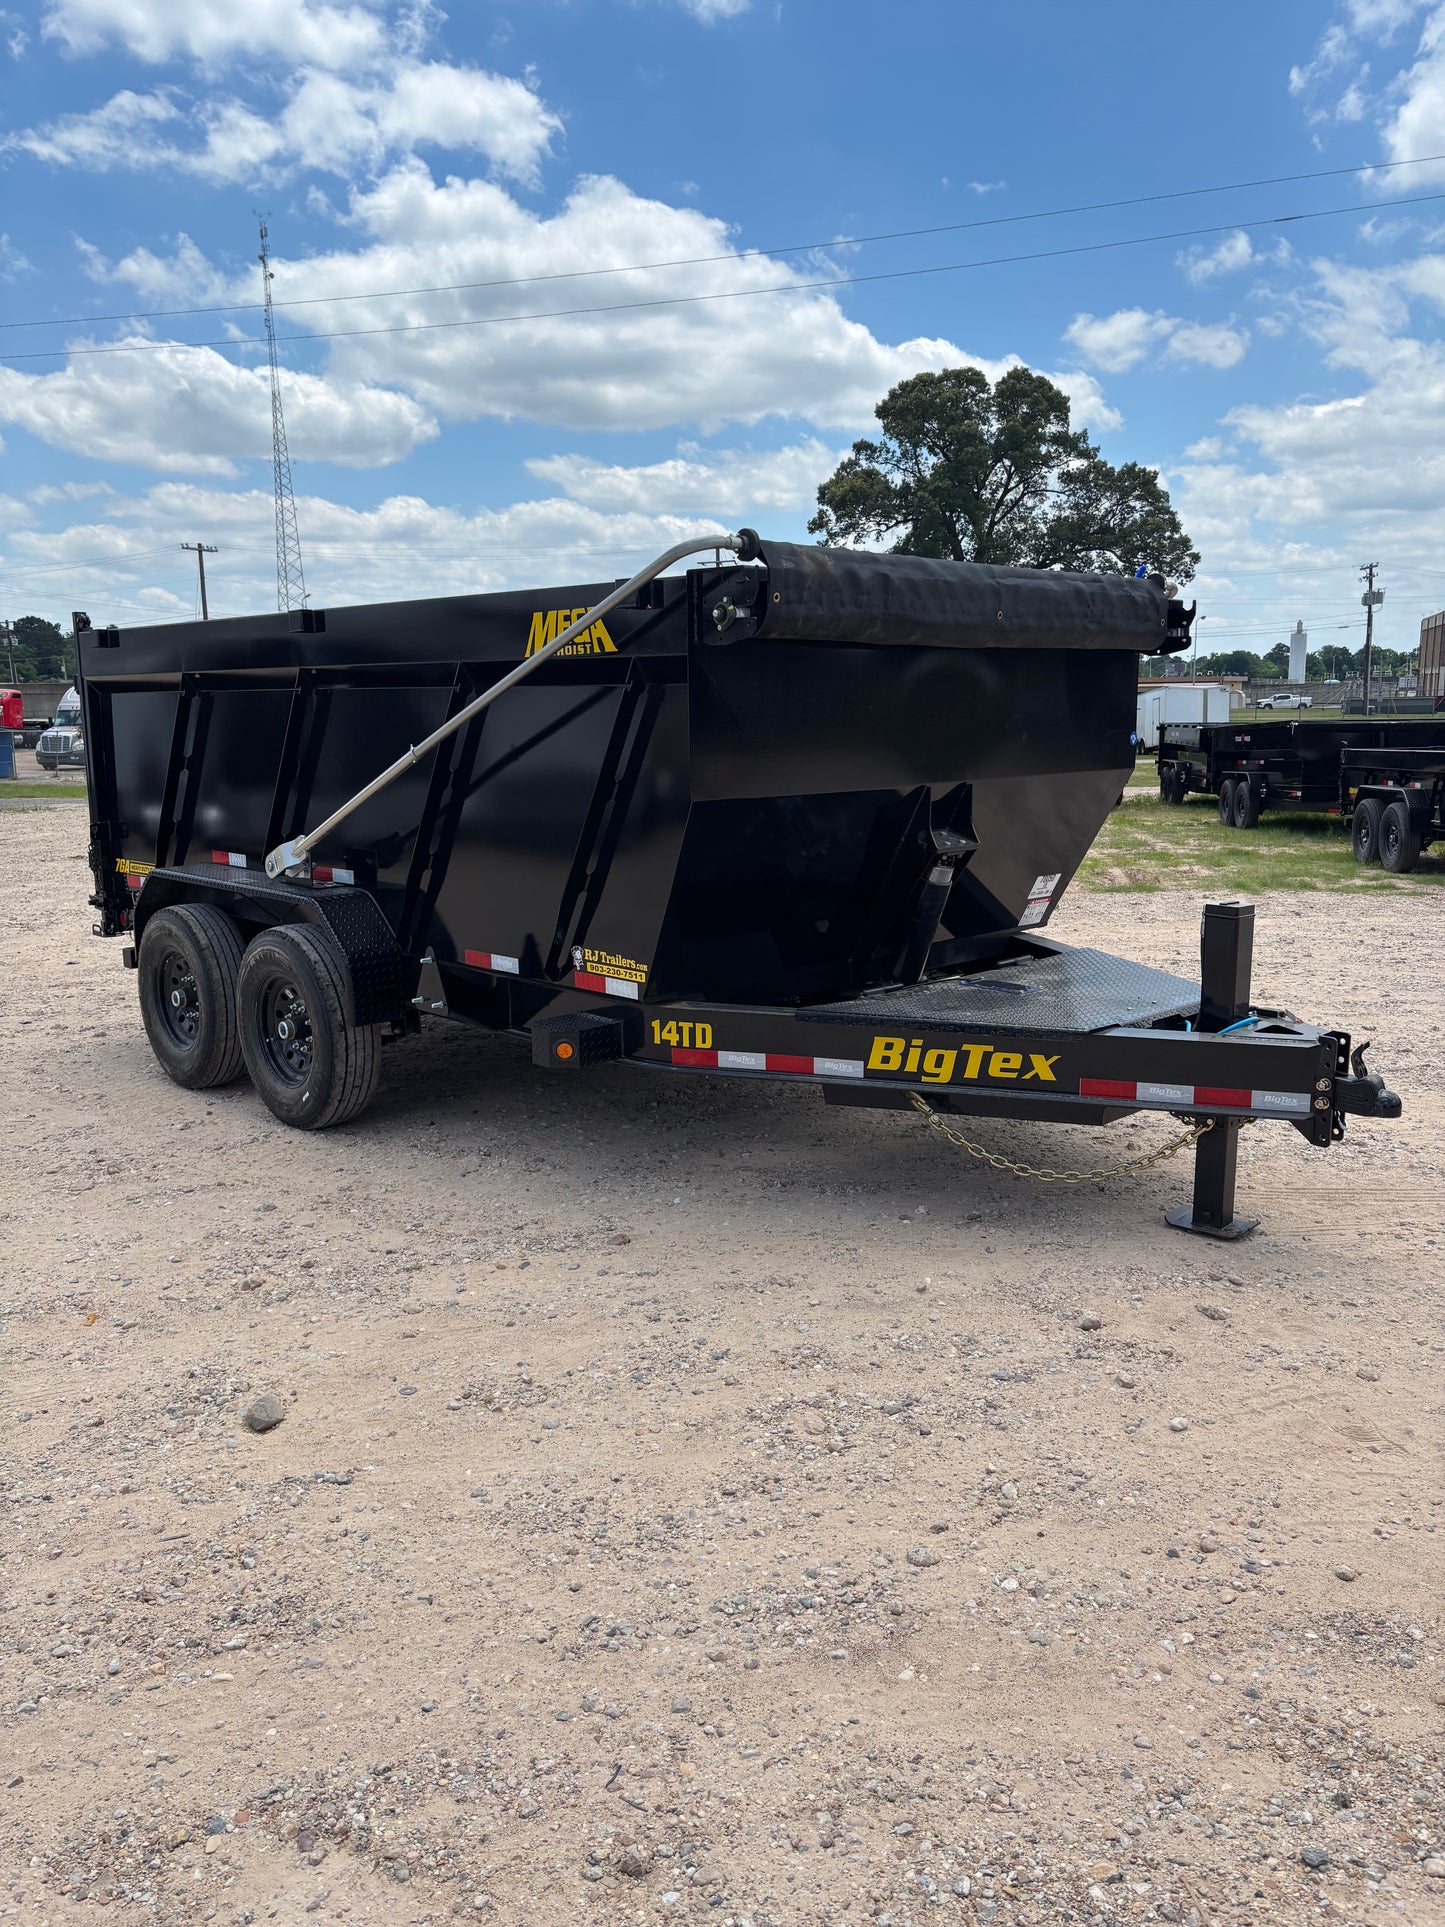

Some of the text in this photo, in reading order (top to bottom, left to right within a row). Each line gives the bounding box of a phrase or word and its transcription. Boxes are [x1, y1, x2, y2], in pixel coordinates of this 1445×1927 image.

[584, 948, 600, 962] RJ
[589, 964, 643, 981] 903-230-7511
[651, 1019, 713, 1049] 14TD
[866, 1036, 1062, 1084] BigTex
